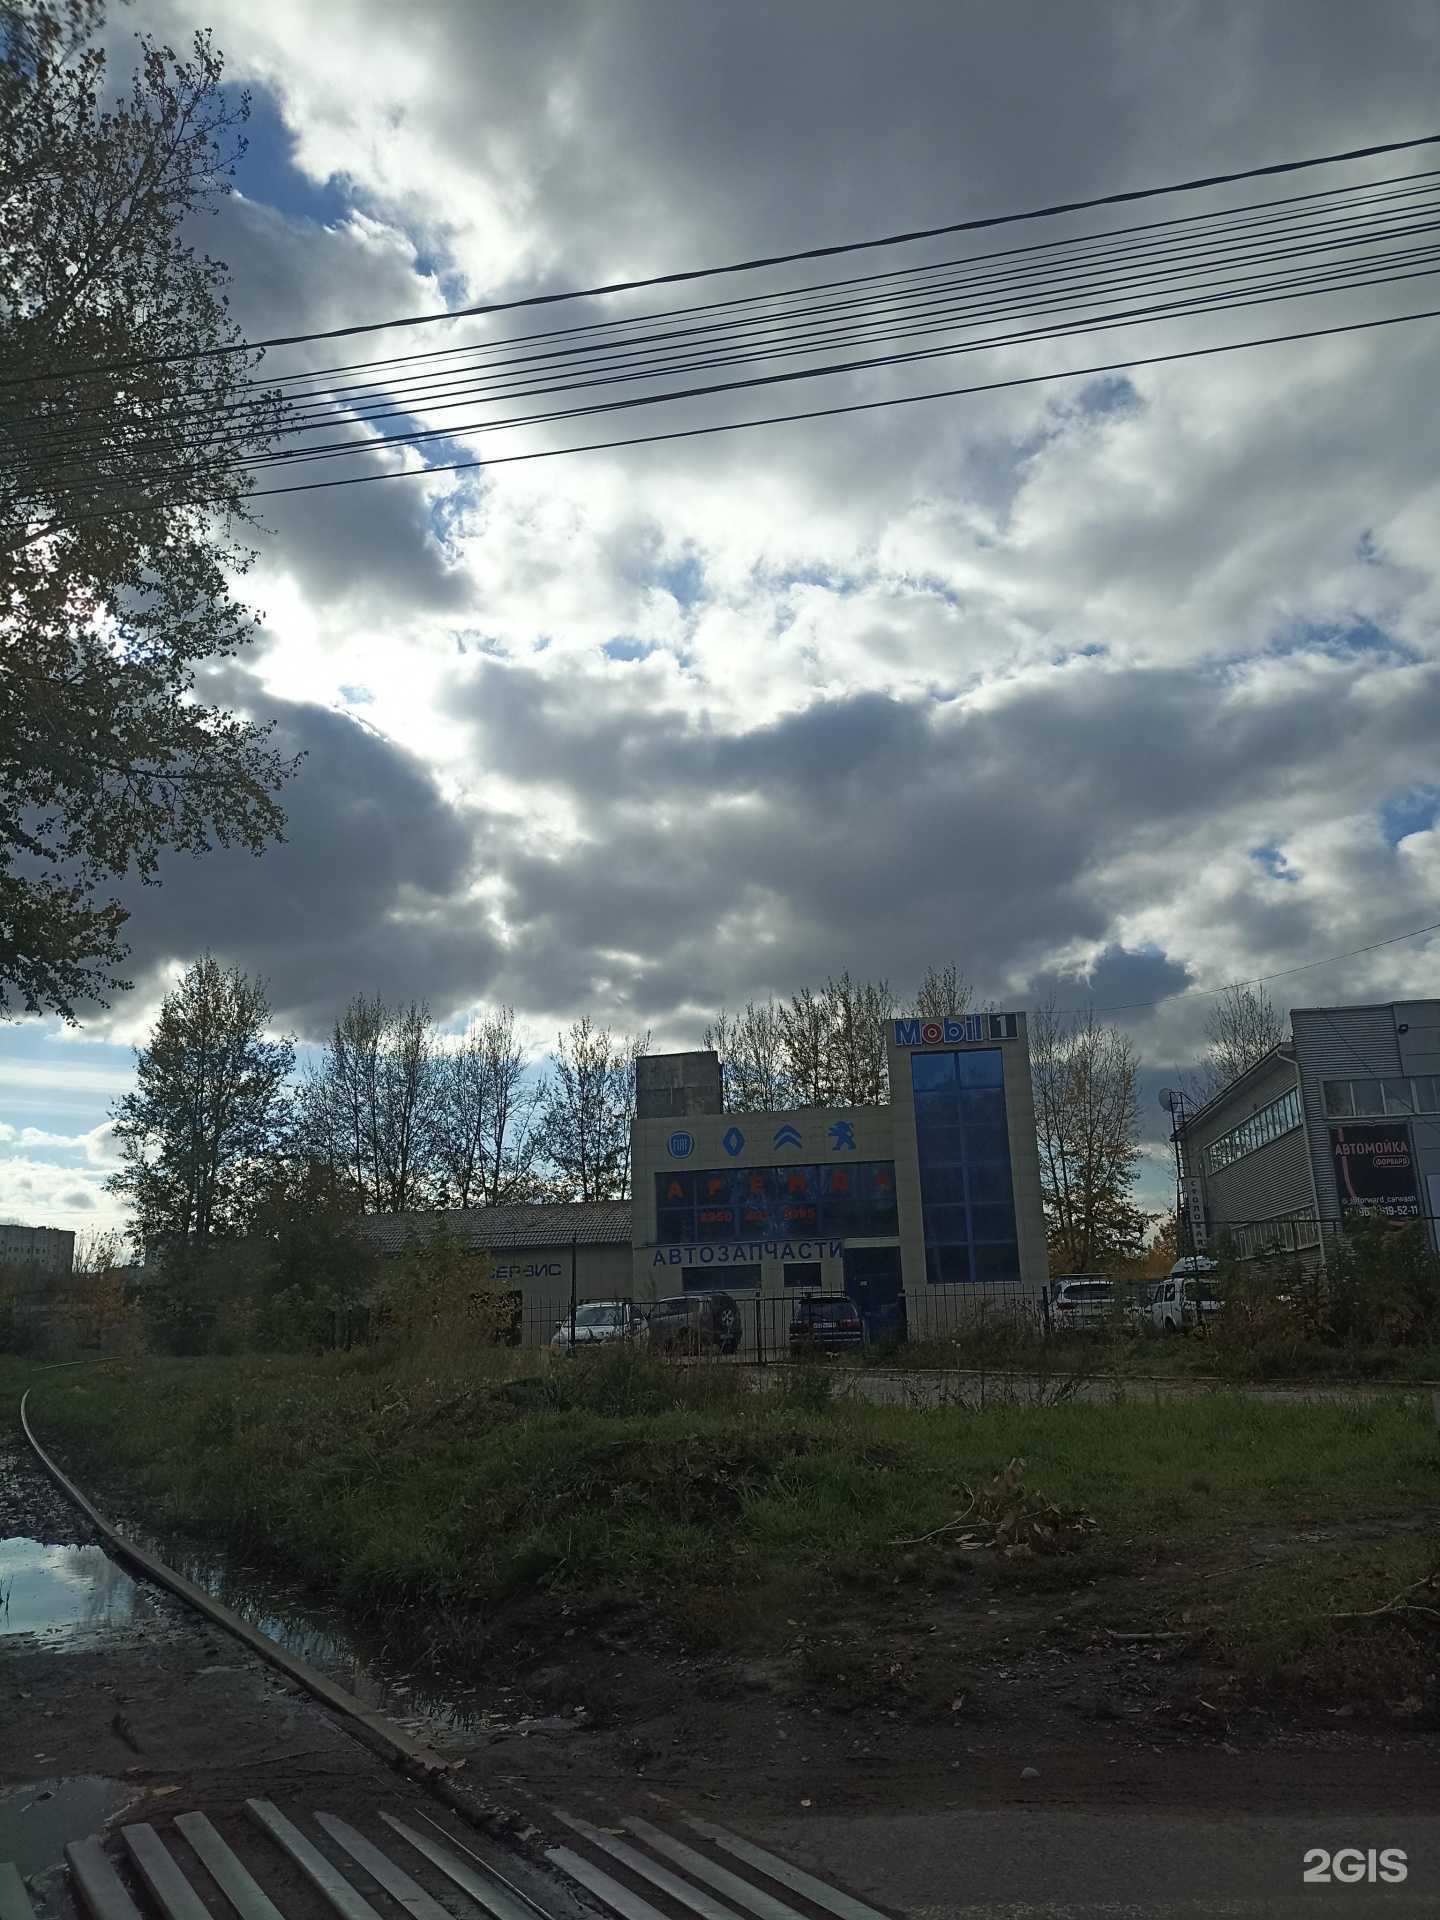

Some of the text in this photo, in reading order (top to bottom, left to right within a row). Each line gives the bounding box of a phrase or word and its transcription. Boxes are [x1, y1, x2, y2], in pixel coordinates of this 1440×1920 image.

[894, 1015, 984, 1046] Mobil
[1335, 1139, 1409, 1155] АВТОМОЙКА
[652, 1239, 843, 1266] АВТОЗАПЧАСТИ
